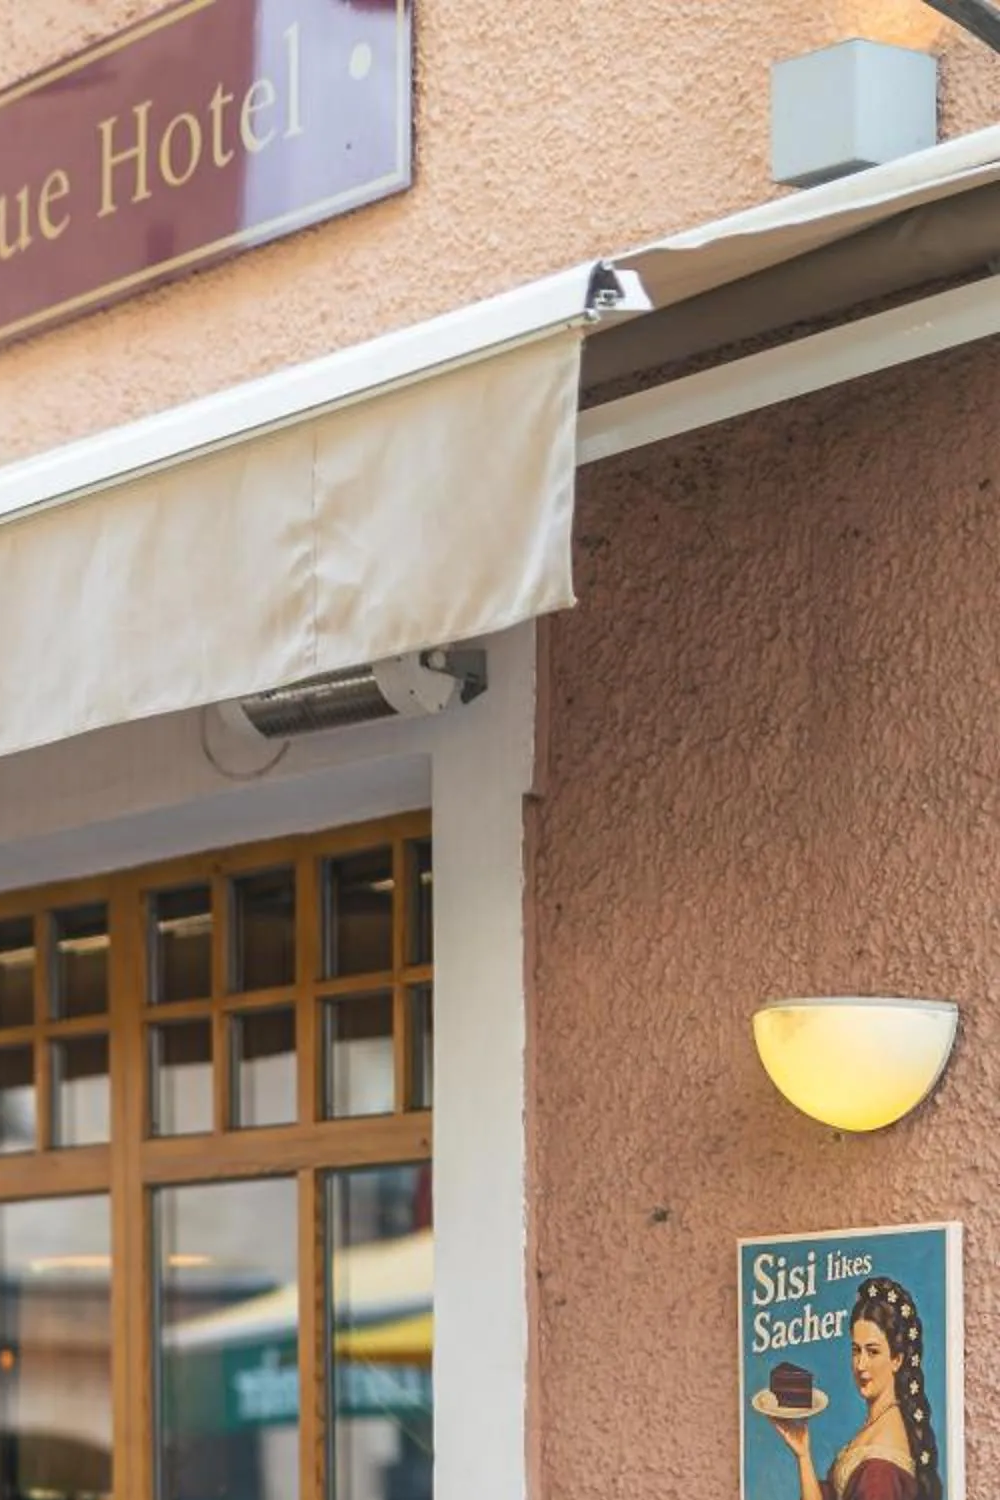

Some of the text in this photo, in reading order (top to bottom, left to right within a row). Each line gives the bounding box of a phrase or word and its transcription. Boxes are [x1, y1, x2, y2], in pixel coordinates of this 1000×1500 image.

[96, 20, 304, 218] Hotel
[752, 1250, 873, 1306] Sisi likes
[752, 1303, 848, 1353] Sacher
